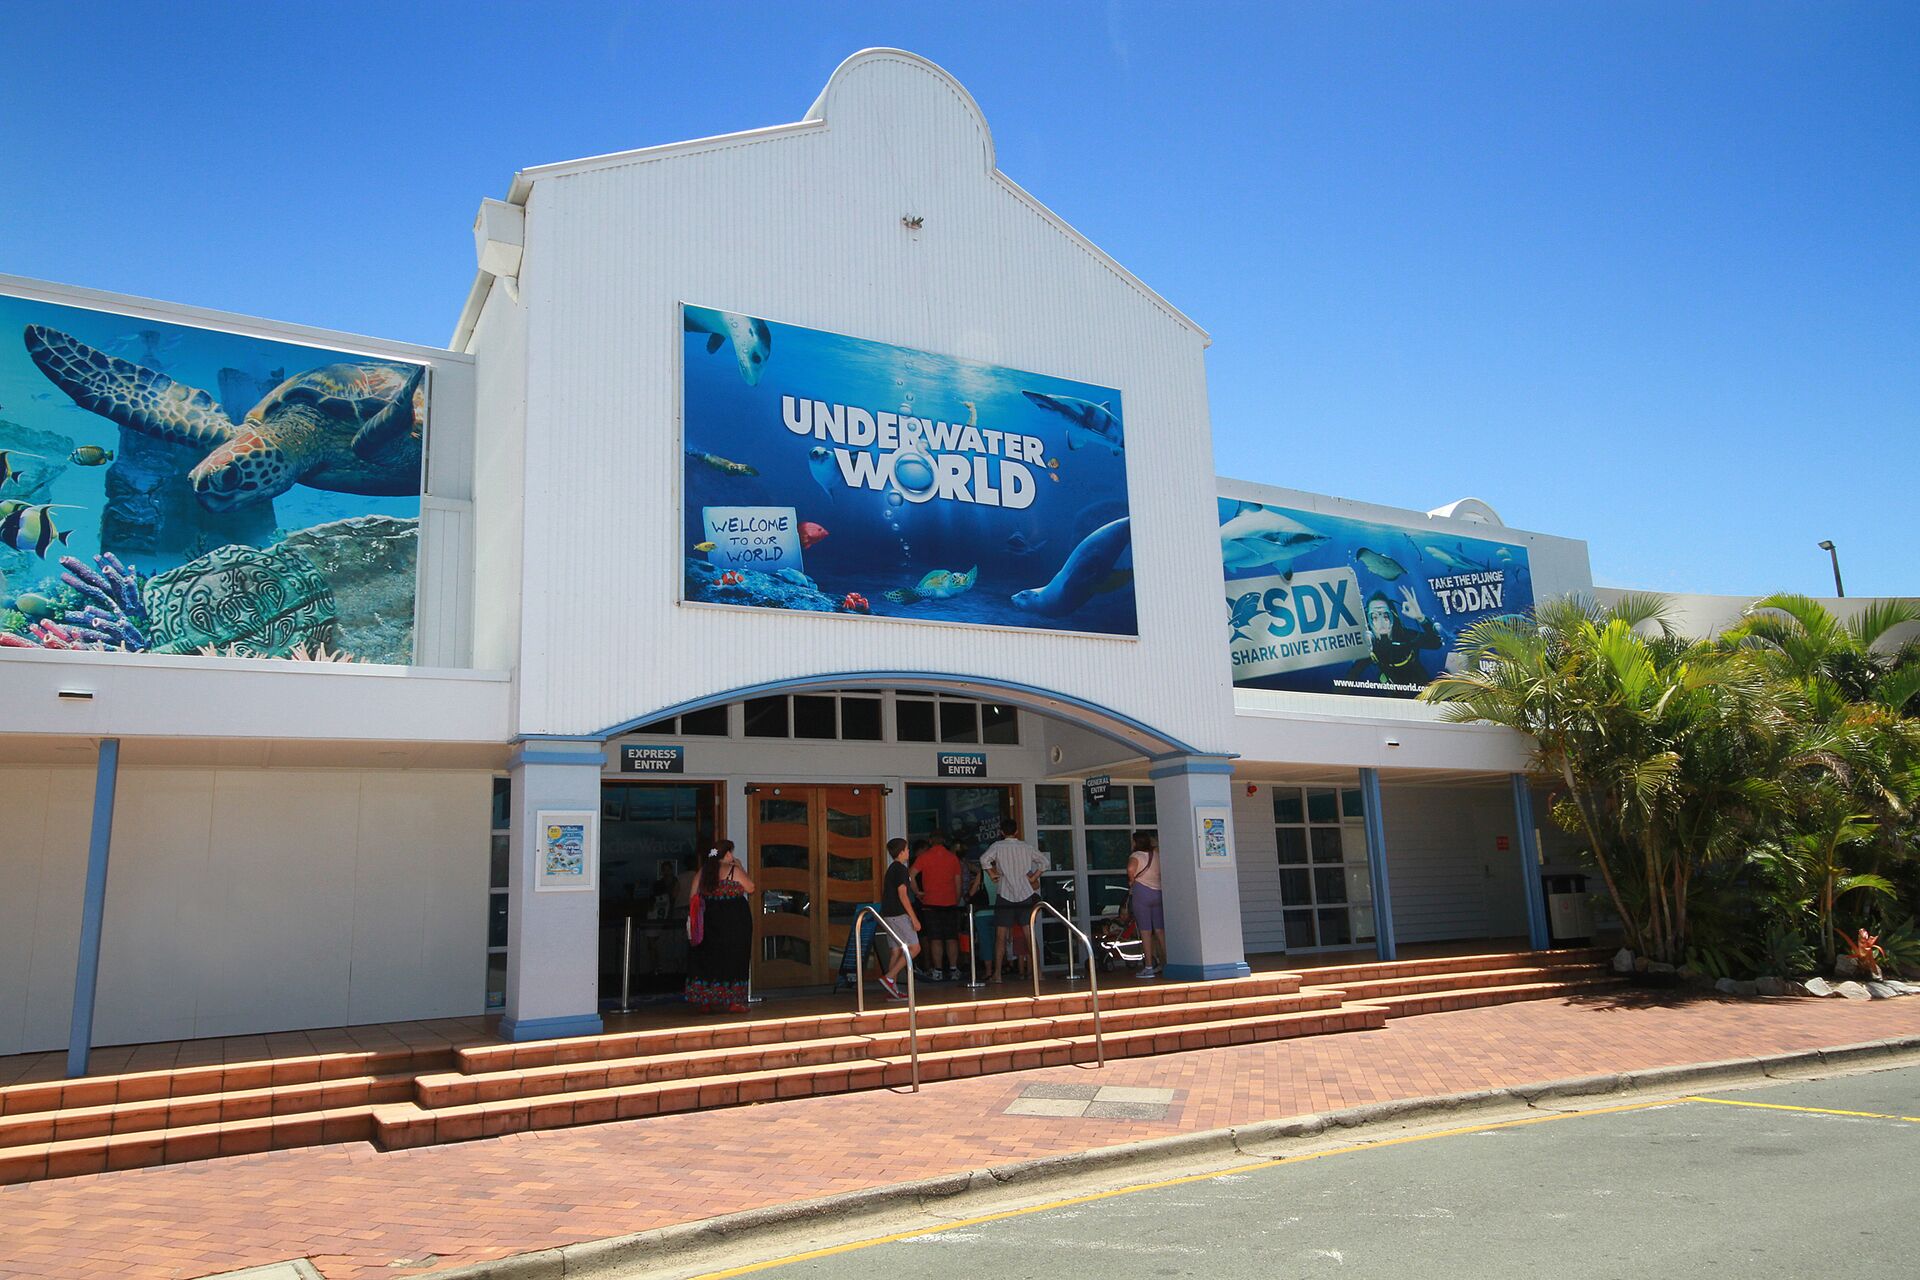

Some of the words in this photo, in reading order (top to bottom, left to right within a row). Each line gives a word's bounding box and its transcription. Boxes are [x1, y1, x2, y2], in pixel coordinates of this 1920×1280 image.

[782, 395, 1047, 467] UNDERWATER
[834, 446, 1037, 509] WORLD
[711, 516, 788, 533] WELCOME
[730, 536, 749, 545] TO
[753, 536, 777, 546] OUR
[726, 546, 784, 563] WORLD
[1428, 577, 1454, 590] TAKE
[1453, 574, 1471, 587] THE
[1470, 570, 1504, 584] PLUNGE
[1436, 583, 1502, 615] TODAY
[1263, 579, 1359, 637] SDX
[1231, 646, 1279, 666] SHARK
[1280, 640, 1310, 657] DIVE
[1312, 631, 1363, 653] XTREME
[1333, 679, 1428, 692] www.underwaterworld.co
[628, 749, 677, 759] EXPRESS
[942, 755, 983, 765] GENERAL
[634, 760, 671, 770] ENTRY
[948, 765, 977, 775] ENTRY
[1087, 777, 1109, 787] GENERAL
[1090, 785, 1106, 794] ENTRY
